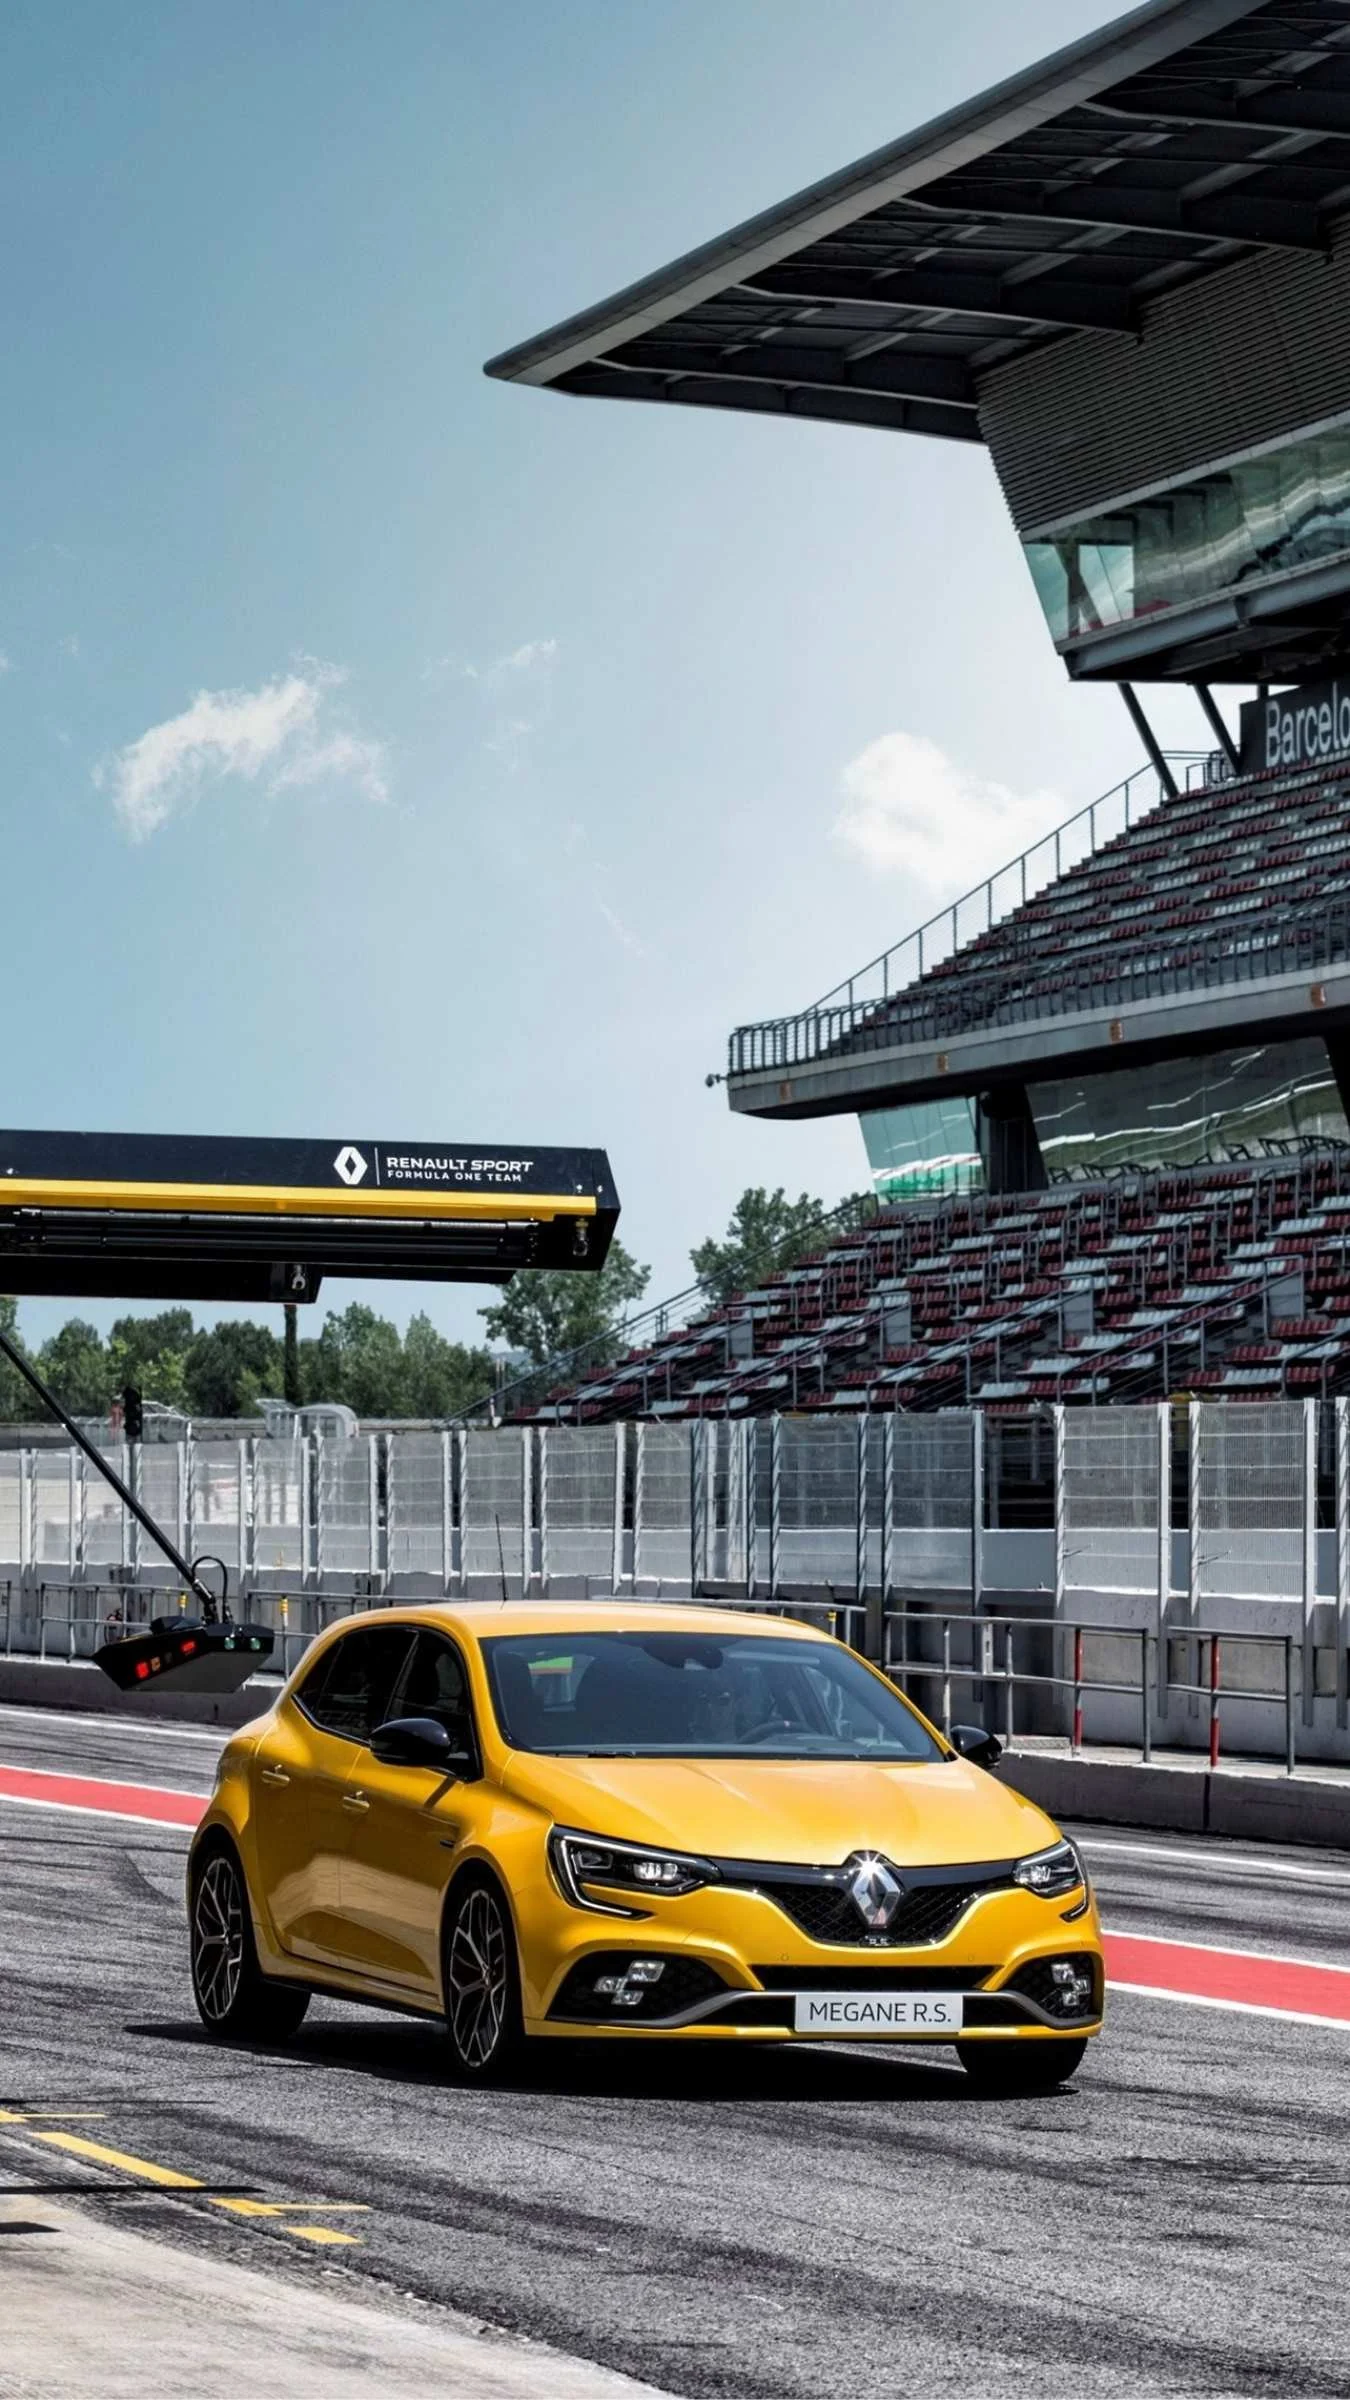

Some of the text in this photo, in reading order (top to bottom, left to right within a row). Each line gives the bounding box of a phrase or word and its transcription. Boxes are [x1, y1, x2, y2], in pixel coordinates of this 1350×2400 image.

[1265, 681, 1350, 768] Barcelo
[387, 1157, 534, 1172] RENAULT SPORT
[387, 1170, 522, 1182] FORMULA ONE TEAM
[809, 2002, 952, 2023] MEGANE R.S.
